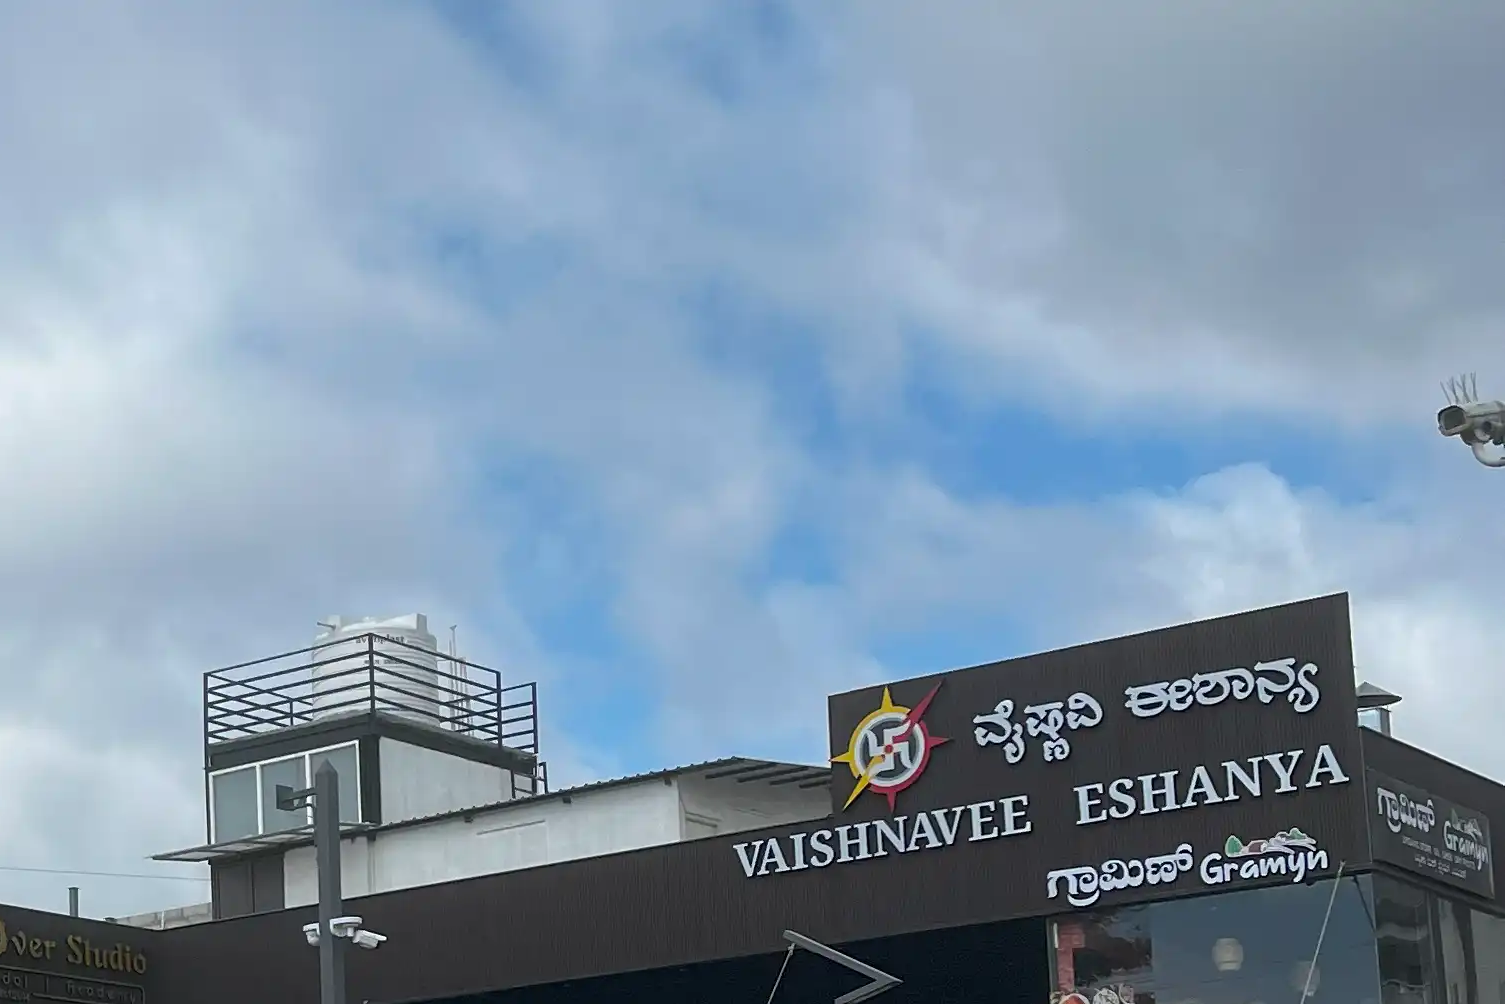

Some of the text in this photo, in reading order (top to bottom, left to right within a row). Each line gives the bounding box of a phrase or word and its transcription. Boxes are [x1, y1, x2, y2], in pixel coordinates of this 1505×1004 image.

[973, 657, 1320, 764] ವೈಷ್ಣವಿ ಈಶಾನ್ಯ
[733, 744, 1349, 878] VAISHNAVEE ESHANYA
[1200, 849, 1328, 884] Gramyn
[1444, 821, 1488, 871] Gramyn
[67, 934, 147, 975] Studio
